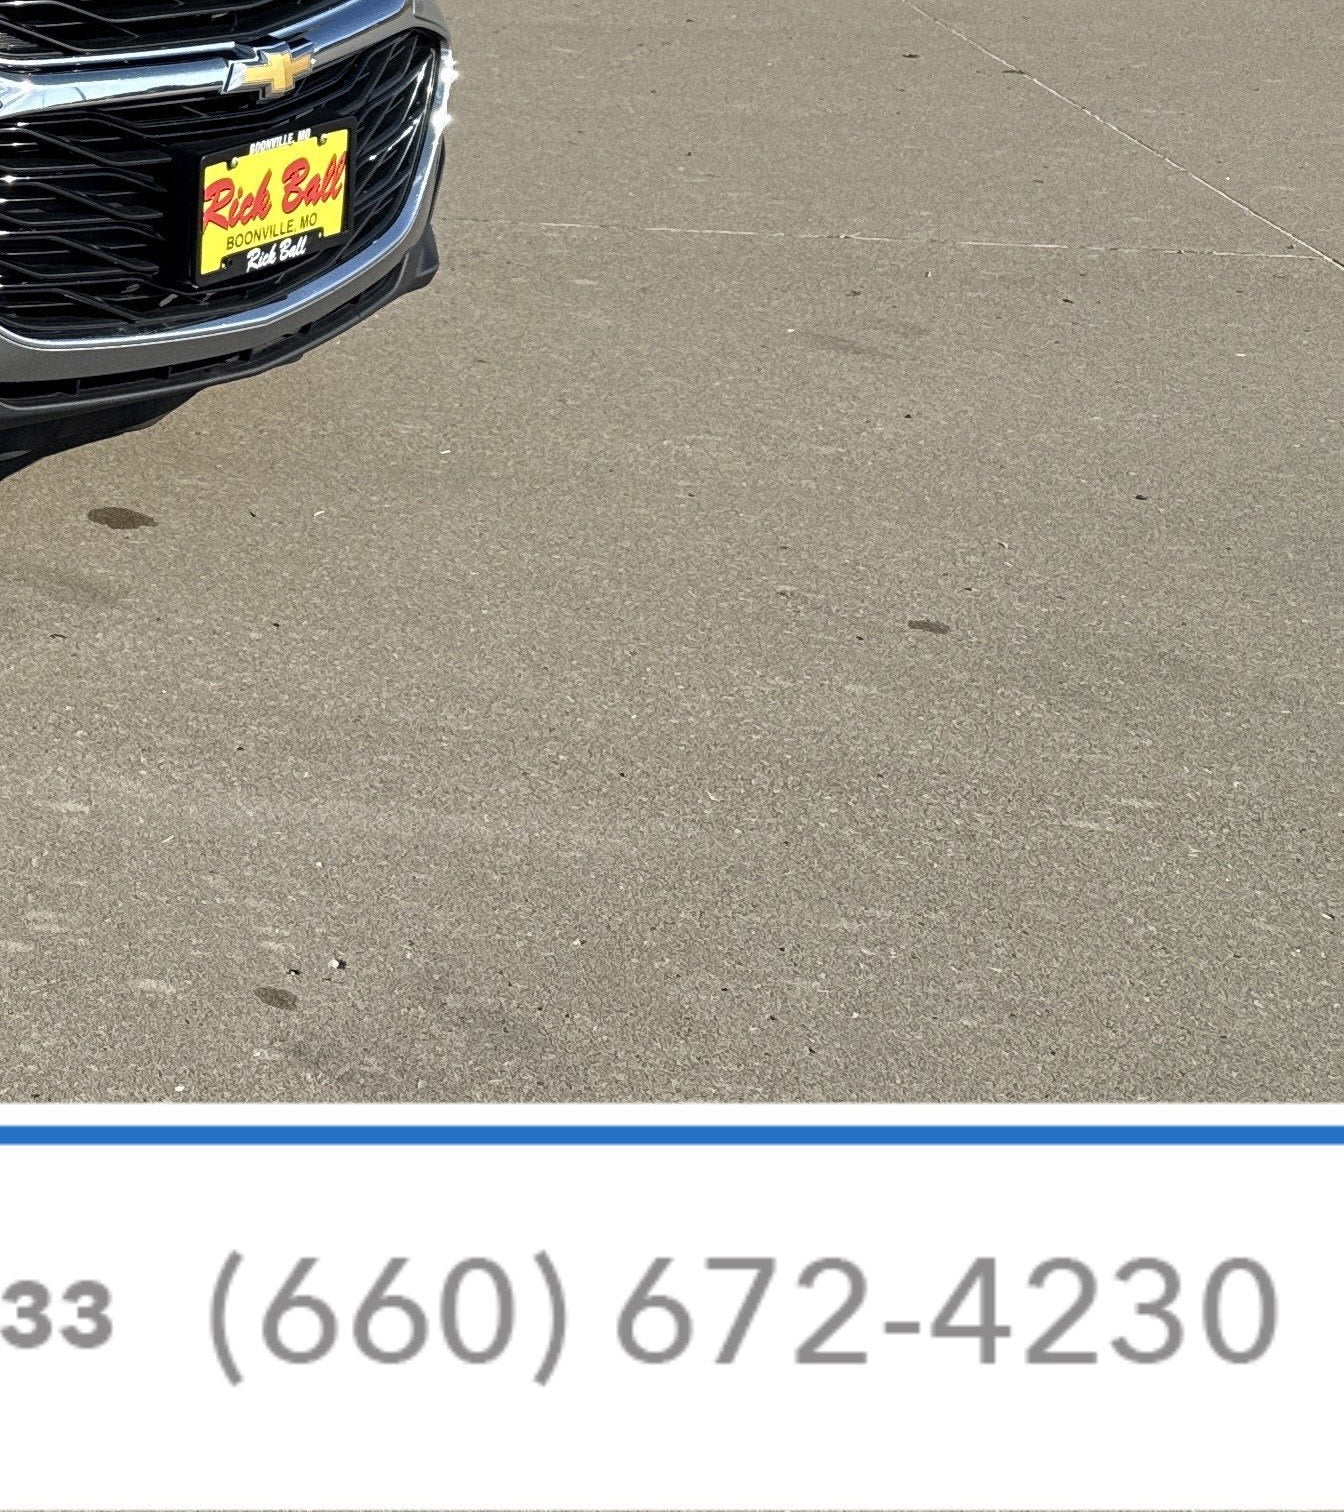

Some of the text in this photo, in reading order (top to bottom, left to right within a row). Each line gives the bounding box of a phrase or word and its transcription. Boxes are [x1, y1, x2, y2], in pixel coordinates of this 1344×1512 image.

[202, 150, 349, 234] Rick Ball
[299, 211, 318, 229] MO
[245, 234, 308, 274] Rick Ball
